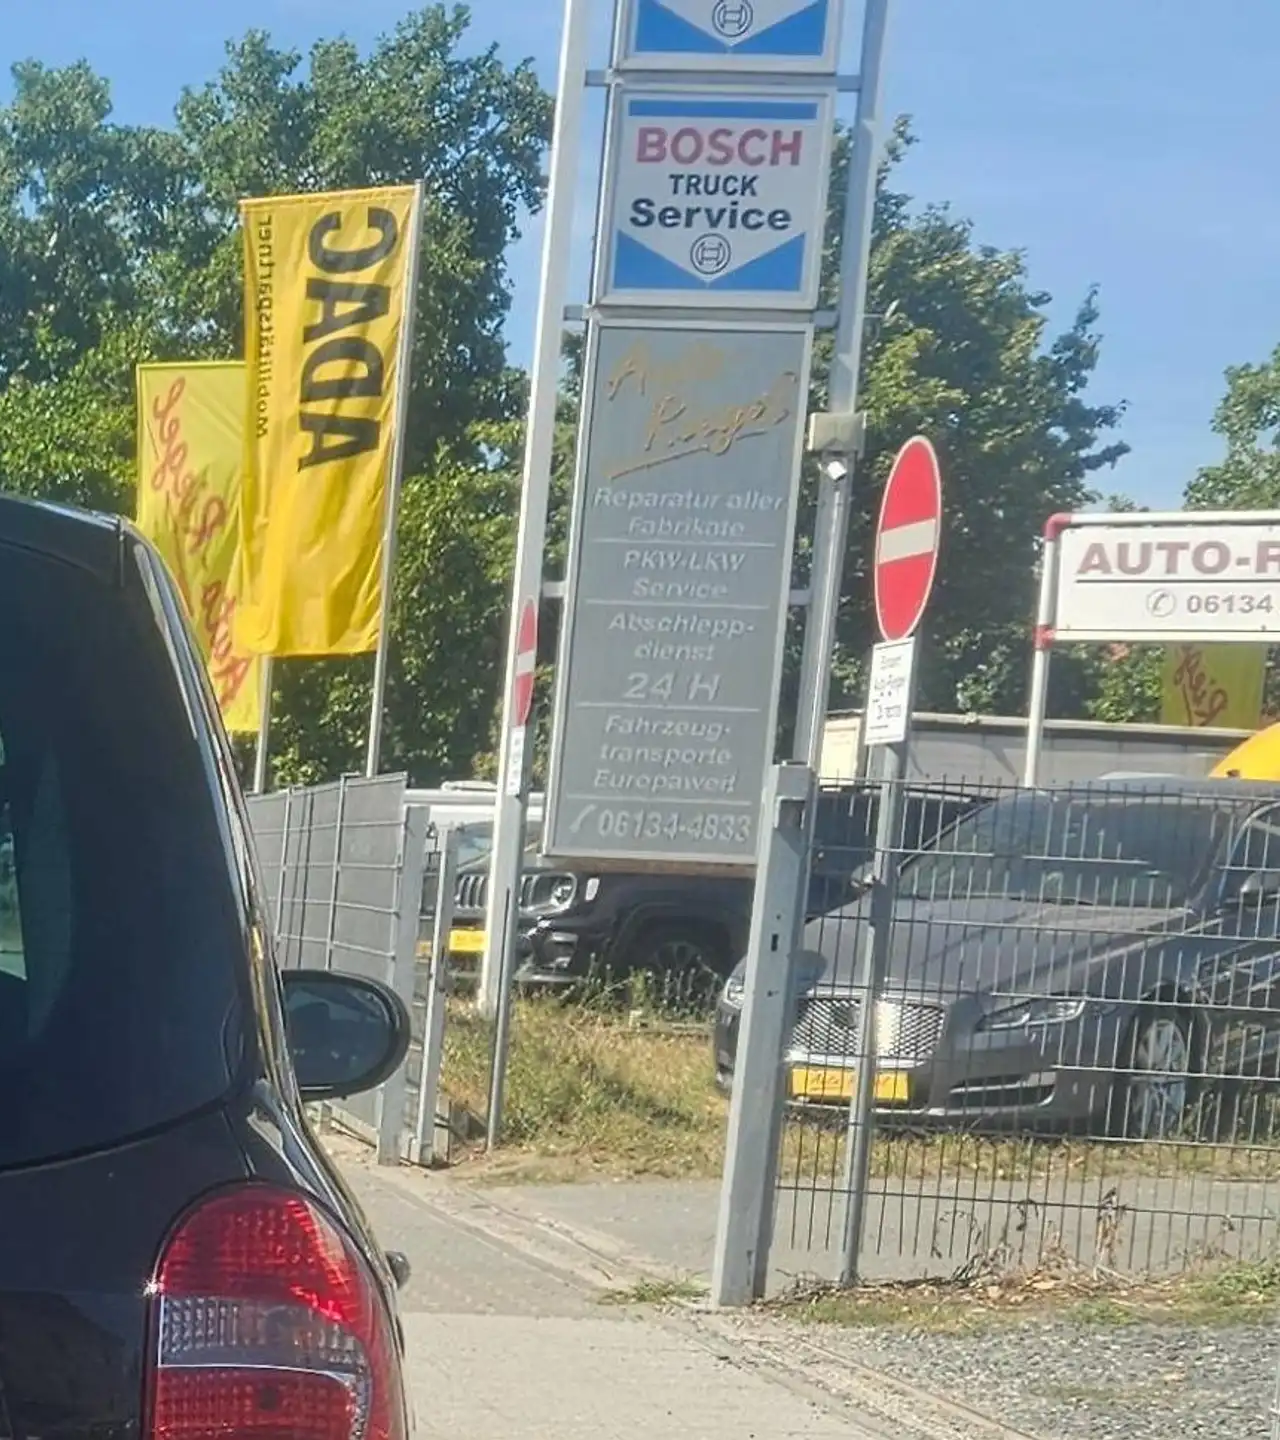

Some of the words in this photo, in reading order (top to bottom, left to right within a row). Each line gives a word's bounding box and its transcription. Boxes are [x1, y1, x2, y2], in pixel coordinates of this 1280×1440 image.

[636, 127, 803, 167] BOSCH
[669, 173, 760, 197] TRUCK
[629, 198, 792, 231] Service
[593, 487, 721, 510] Reparatur
[725, 489, 783, 512] aller
[628, 516, 746, 538] Fabrikate
[624, 549, 746, 572] PKW-LKW
[632, 577, 729, 600] Service
[1186, 594, 1274, 614] 06134
[608, 612, 755, 640] Abschlepp-
[634, 639, 716, 661] dienst
[623, 672, 676, 700] 24
[688, 673, 721, 701] H
[605, 715, 731, 742] Fahrzeug-
[600, 743, 733, 768] transporte
